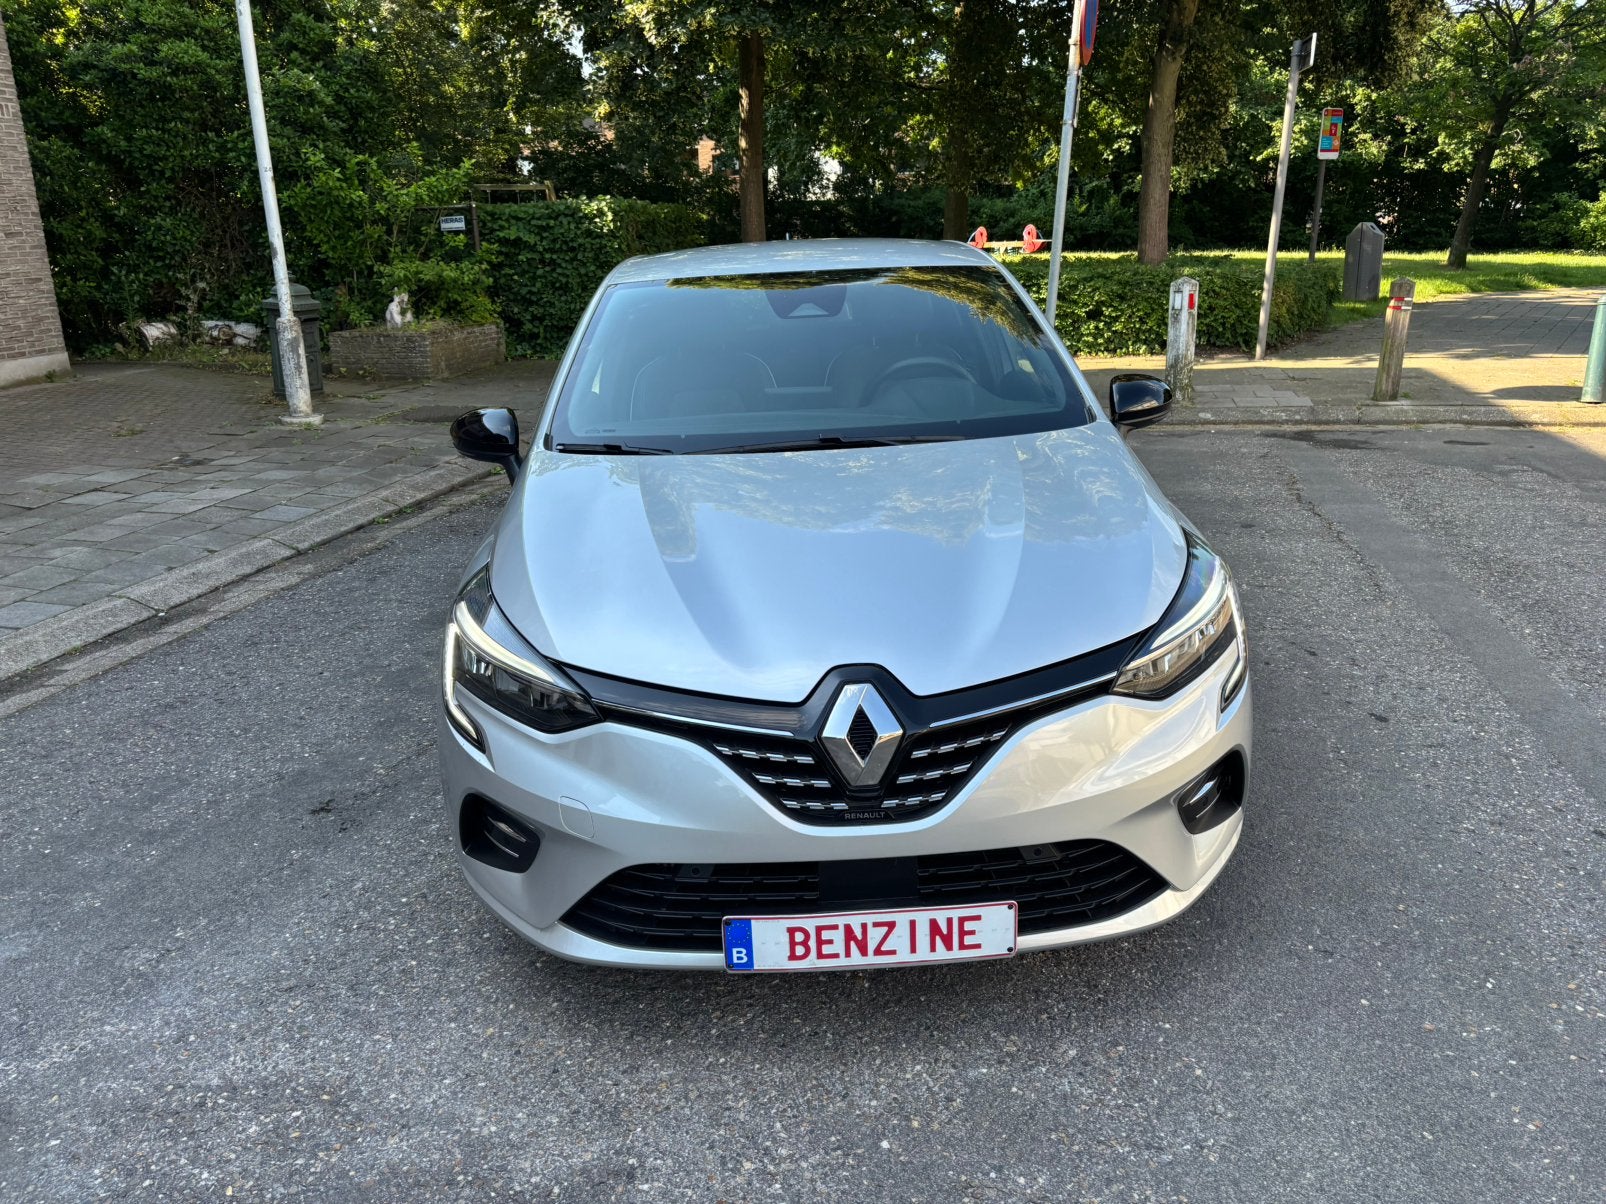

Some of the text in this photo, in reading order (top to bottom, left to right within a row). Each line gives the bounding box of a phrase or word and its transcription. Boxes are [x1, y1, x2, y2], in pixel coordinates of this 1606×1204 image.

[844, 811, 886, 820] RENAULT
[786, 914, 982, 961] BENZINE
[732, 947, 748, 963] B
